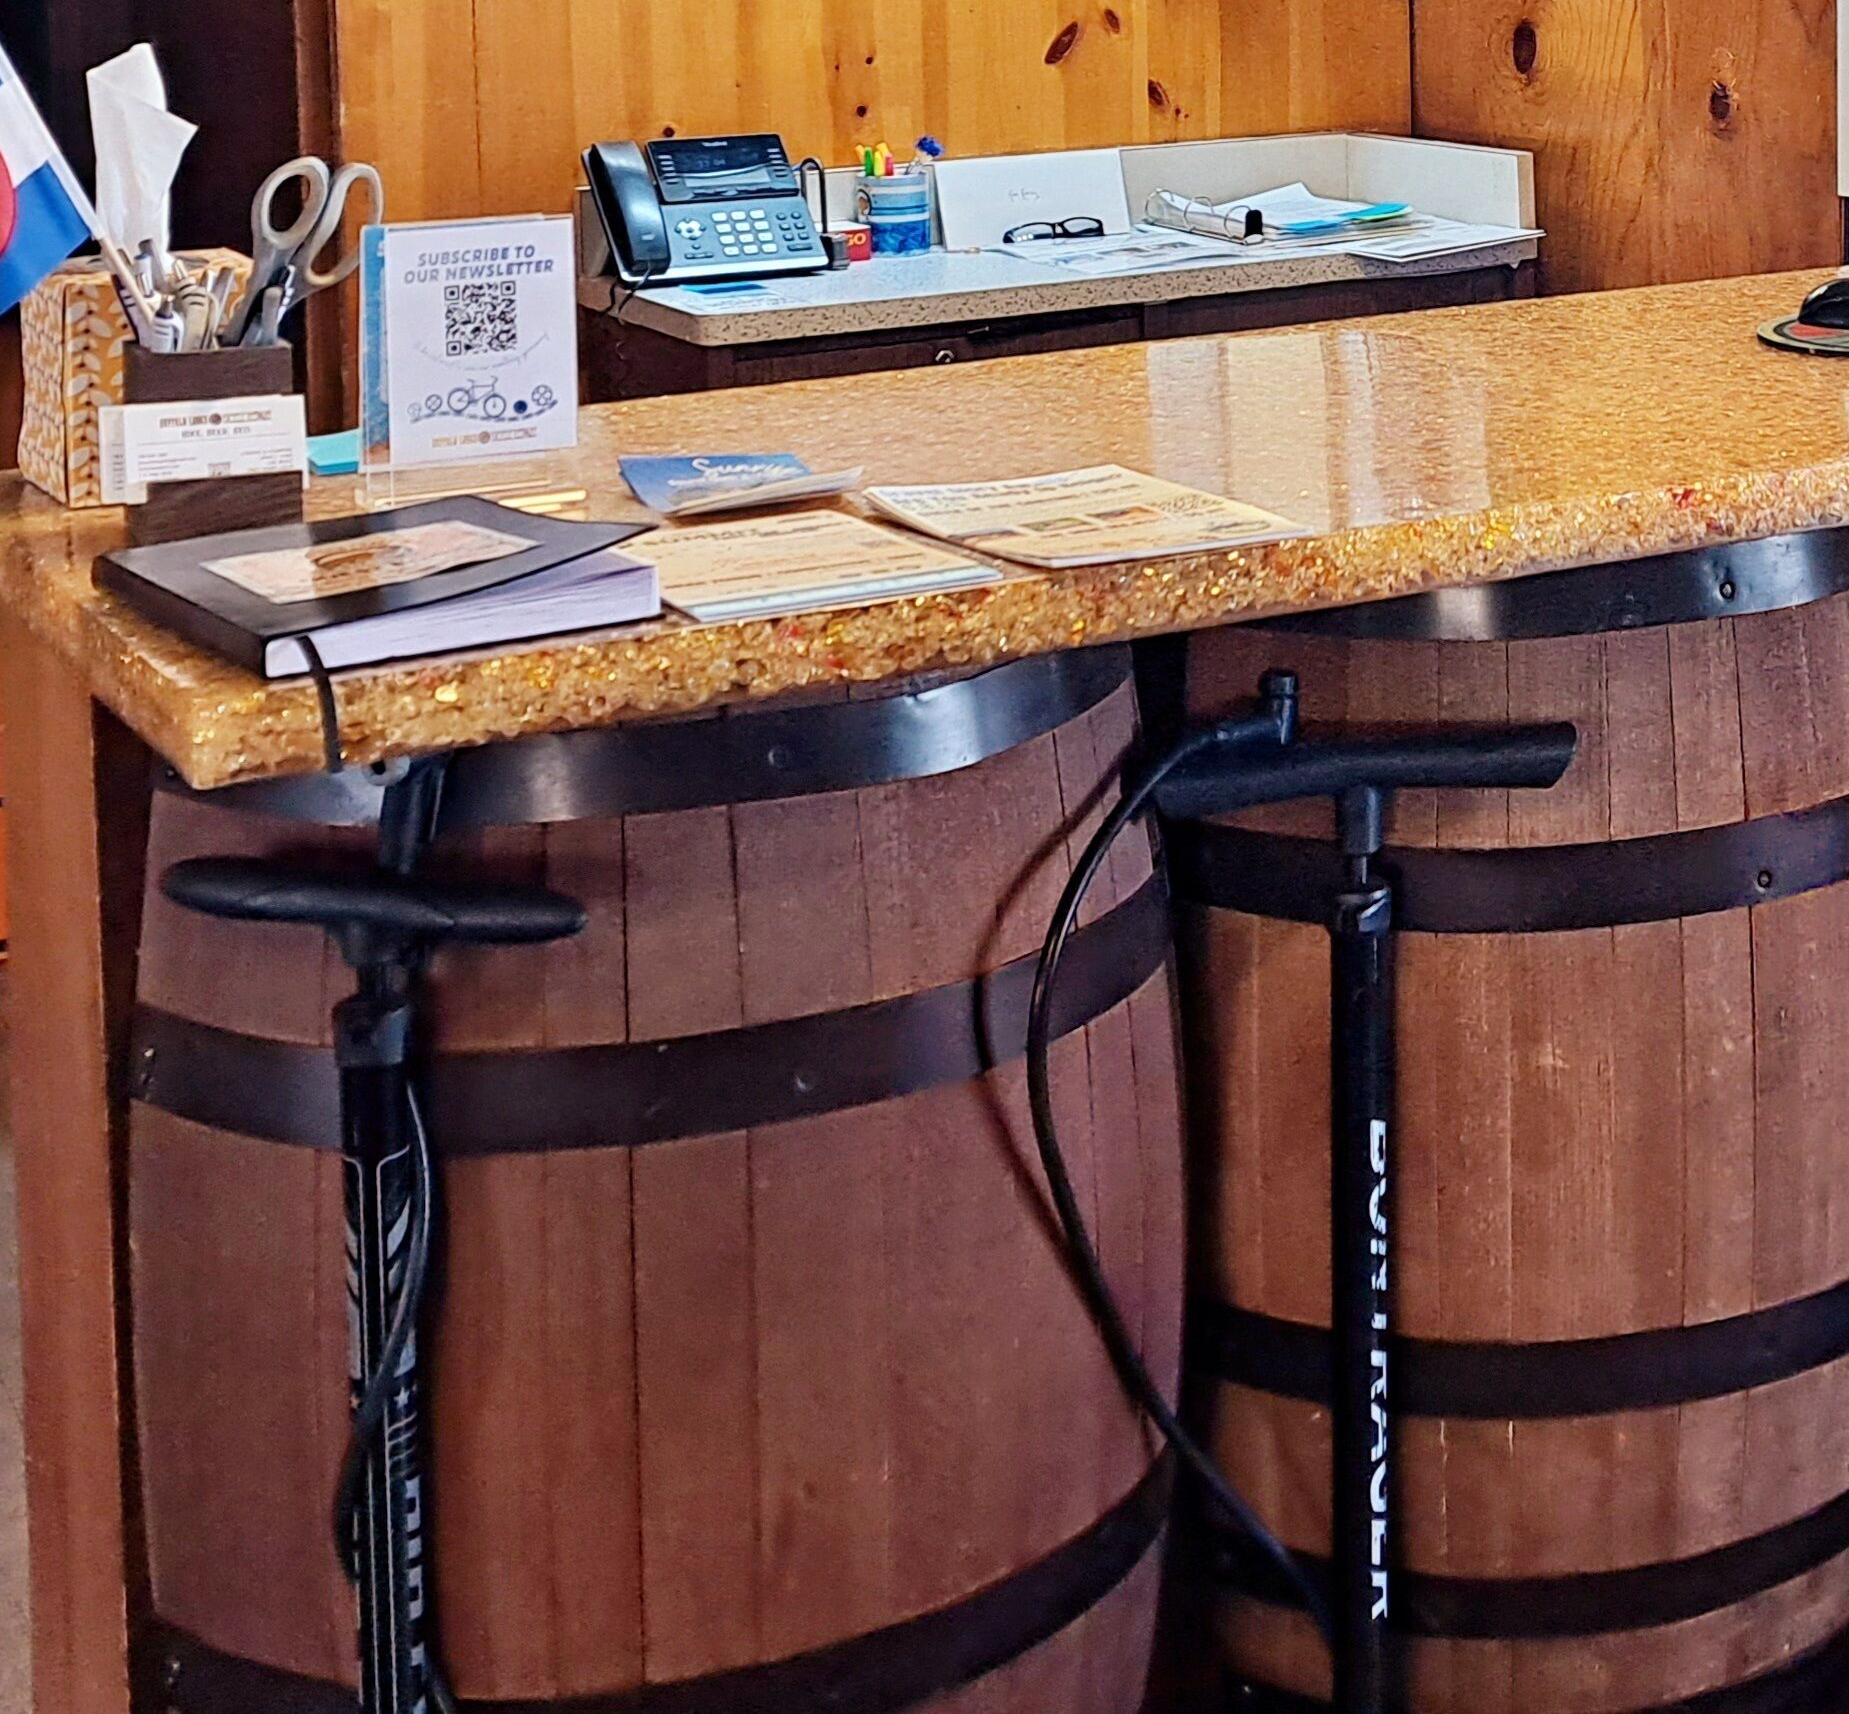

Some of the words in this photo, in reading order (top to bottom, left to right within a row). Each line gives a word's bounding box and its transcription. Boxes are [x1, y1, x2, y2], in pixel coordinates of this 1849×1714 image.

[418, 246, 510, 268] SUBSCRIBE
[514, 244, 536, 259] TO
[404, 269, 440, 284] OUR
[444, 259, 554, 282] NEWSLETTER
